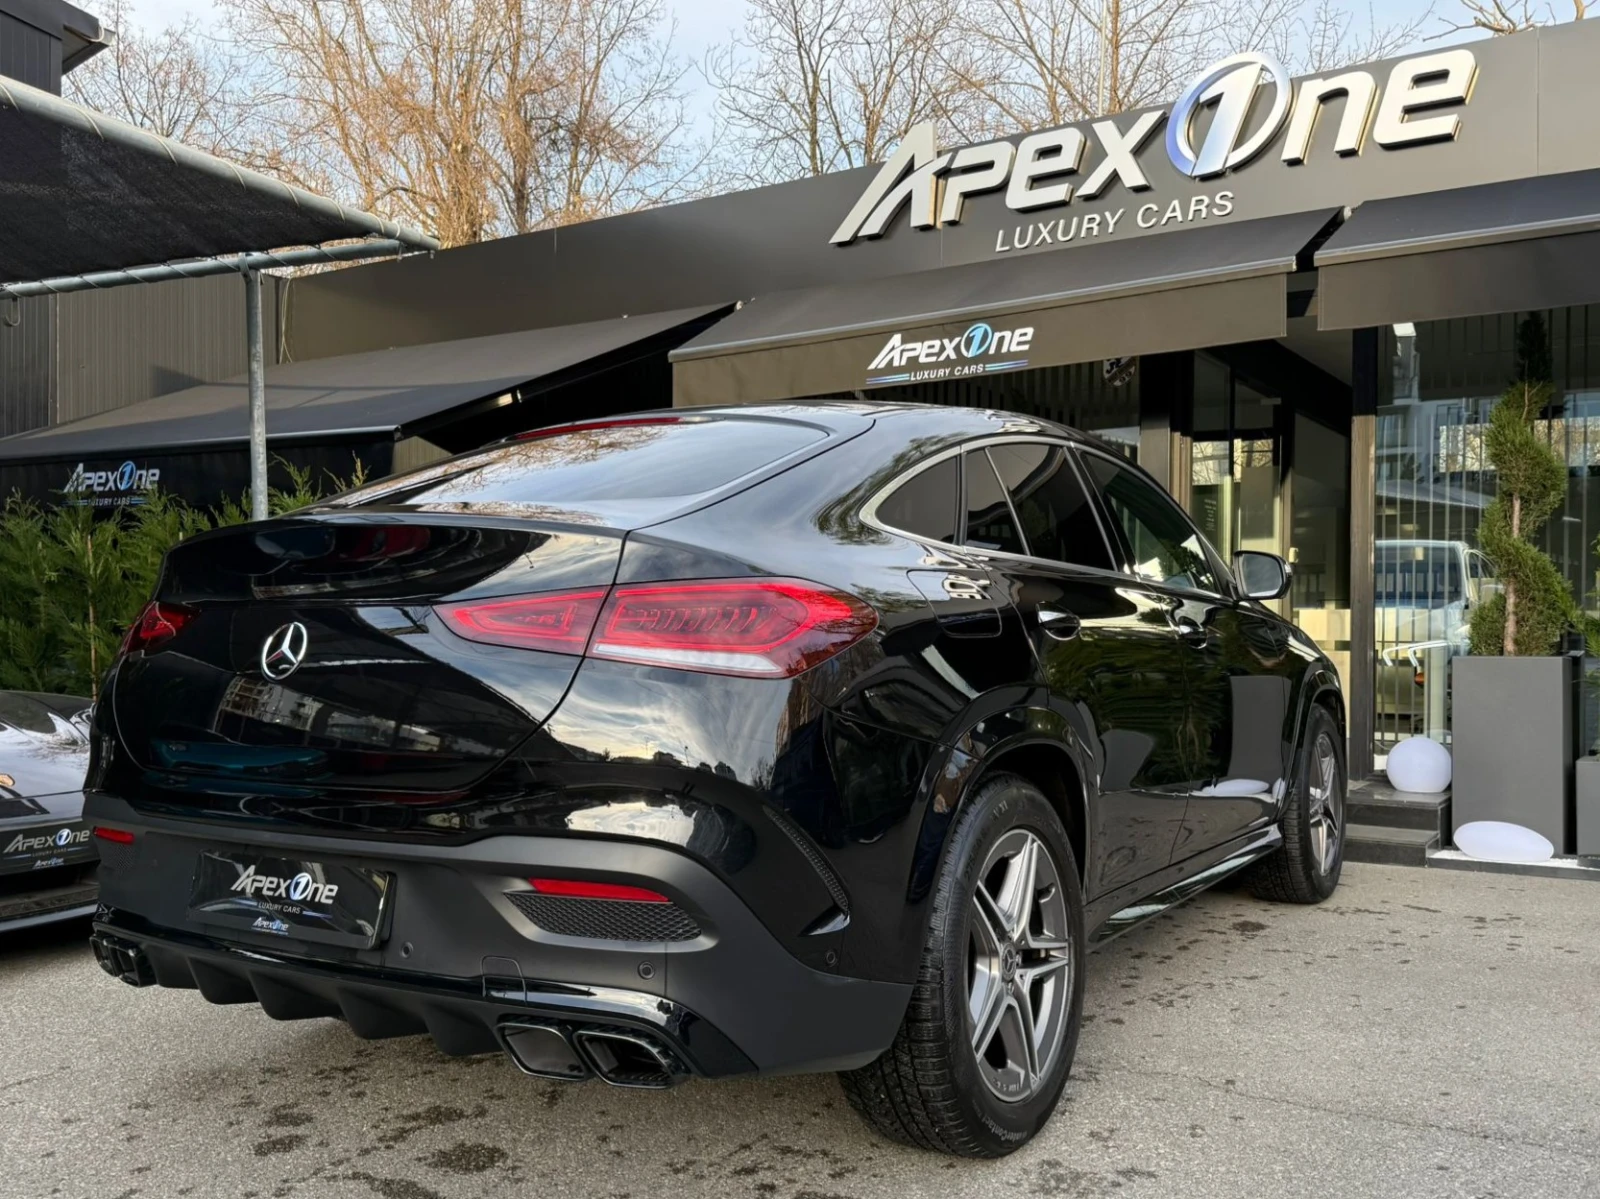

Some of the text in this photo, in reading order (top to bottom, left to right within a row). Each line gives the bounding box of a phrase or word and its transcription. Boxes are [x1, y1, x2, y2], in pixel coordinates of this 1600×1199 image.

[995, 191, 1235, 253] LUXURY CARS
[910, 363, 984, 382] LUXURY CARS
[258, 901, 301, 915] LUXURY CARS
